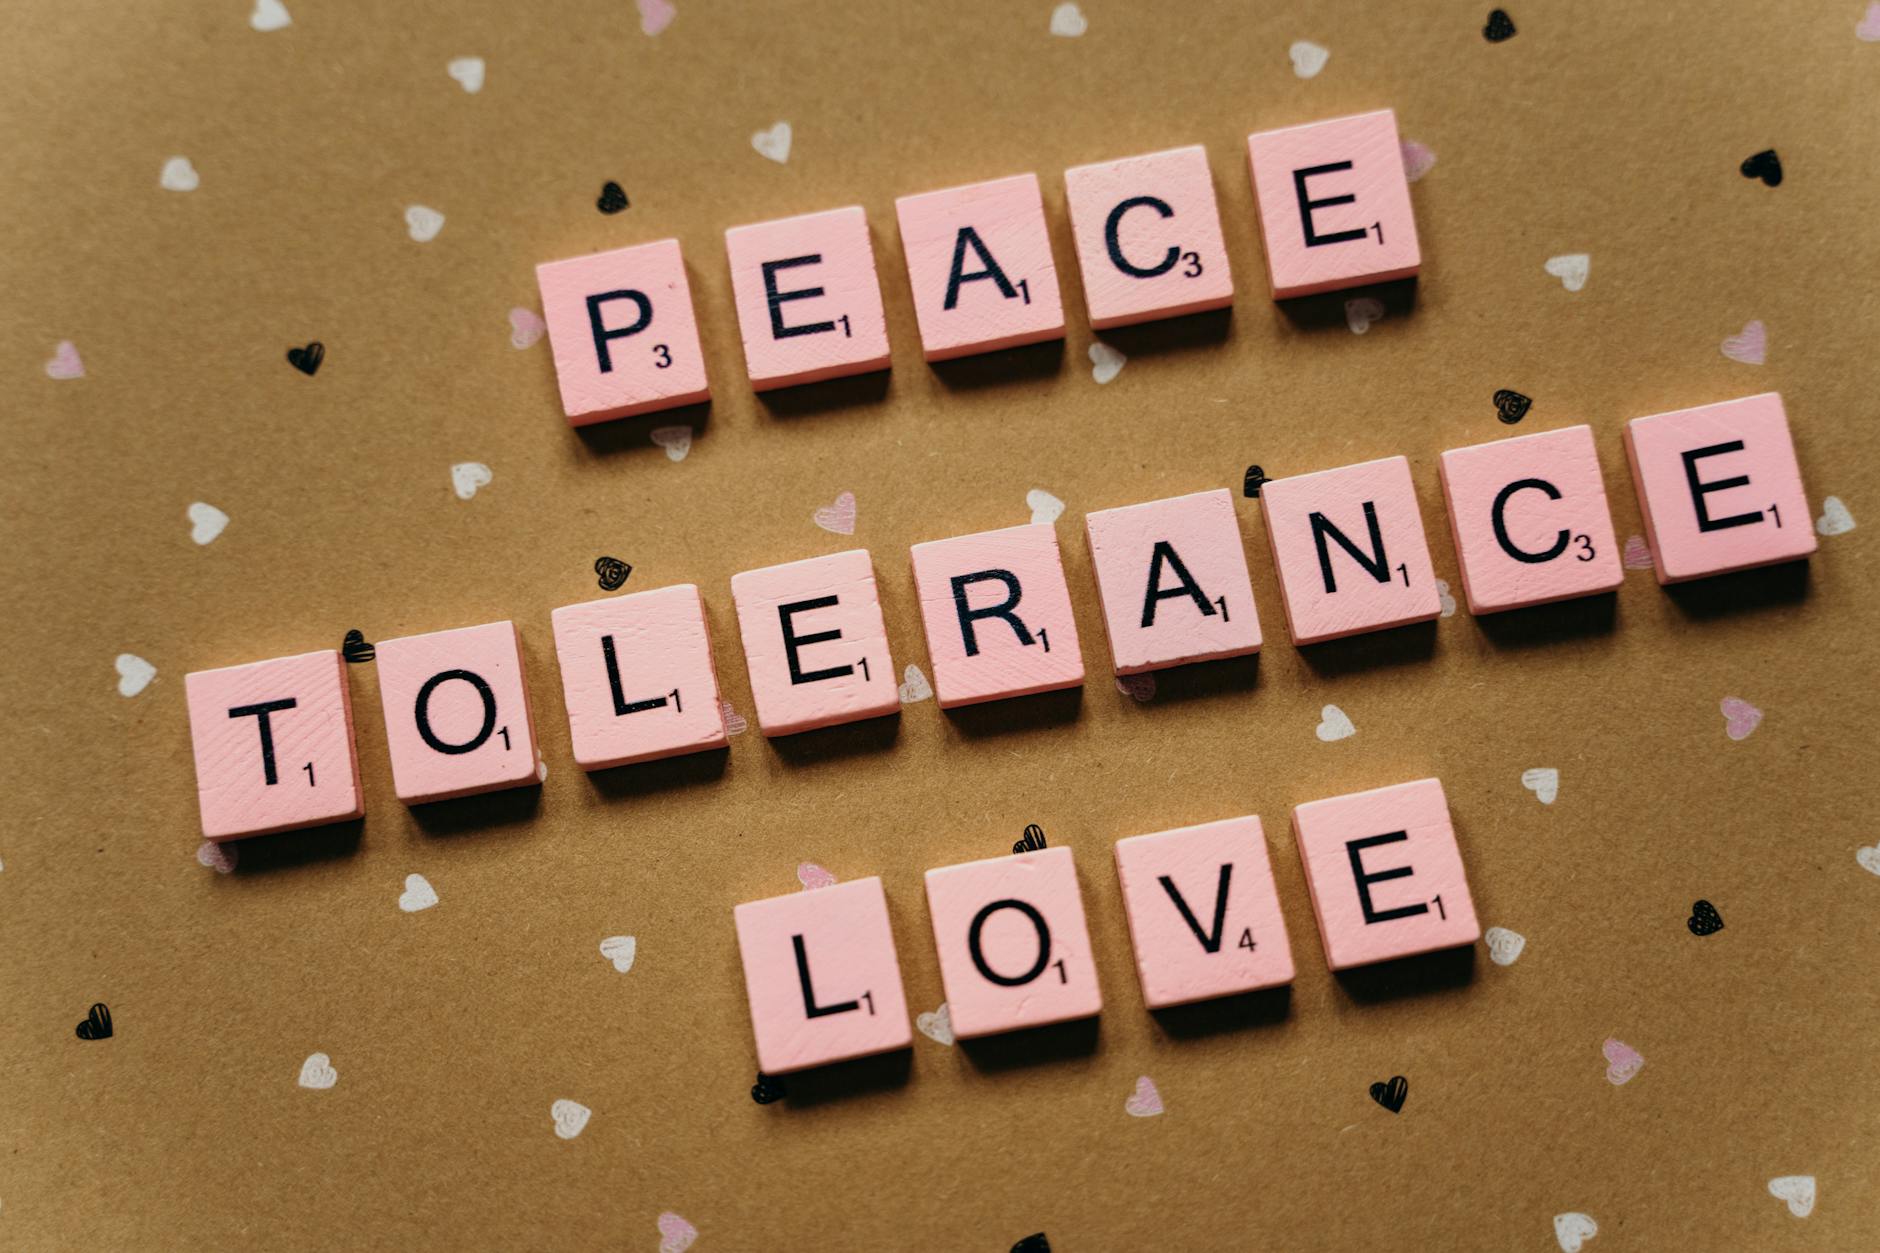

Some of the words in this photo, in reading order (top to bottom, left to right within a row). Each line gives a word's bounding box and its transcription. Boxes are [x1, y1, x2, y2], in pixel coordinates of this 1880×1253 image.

[1370, 221, 1385, 246] 1
[585, 159, 1368, 375] PEACE
[1181, 251, 1204, 279] 3
[1015, 278, 1031, 305] 1
[837, 314, 852, 338] 1
[652, 343, 673, 369] 3
[1767, 503, 1782, 529] 1
[1573, 534, 1596, 563] 3
[1396, 562, 1411, 588] 1
[227, 439, 1765, 786] TOLERANCE
[1213, 595, 1230, 623] 1
[1035, 627, 1051, 653] 1
[856, 656, 871, 682] 1
[668, 688, 683, 714] 1
[496, 725, 511, 752] 1
[302, 761, 316, 788] 1
[1431, 894, 1447, 921] 1
[791, 829, 1430, 1020] LOVE
[1238, 927, 1257, 953] 4
[1052, 959, 1068, 985] 1
[861, 990, 875, 1016] 1
